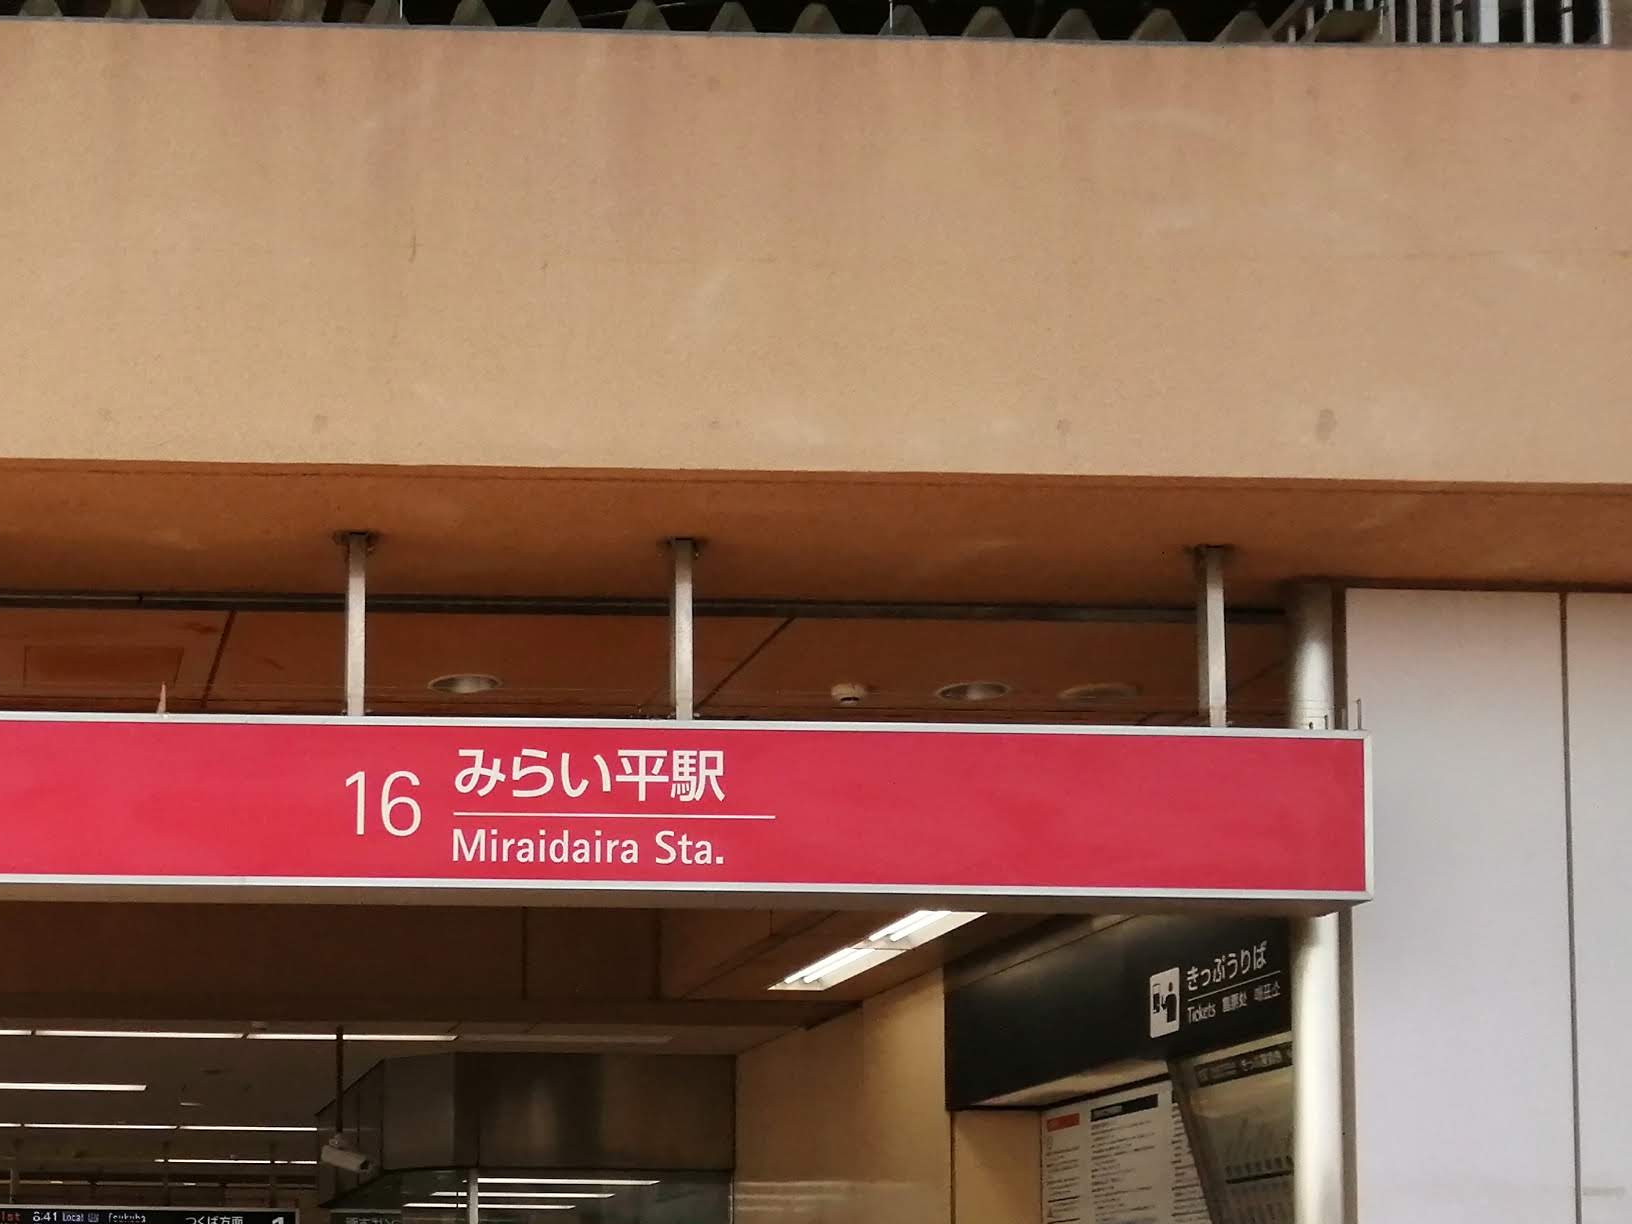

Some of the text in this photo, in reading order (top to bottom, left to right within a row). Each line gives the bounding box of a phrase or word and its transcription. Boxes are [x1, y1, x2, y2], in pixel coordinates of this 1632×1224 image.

[455, 748, 725, 802] みらい平駅
[345, 770, 422, 837] 16
[452, 828, 724, 866] Miraidaira Sta.
[1187, 941, 1268, 991] きっぷうりば
[1187, 1004, 1216, 1024] Tickets
